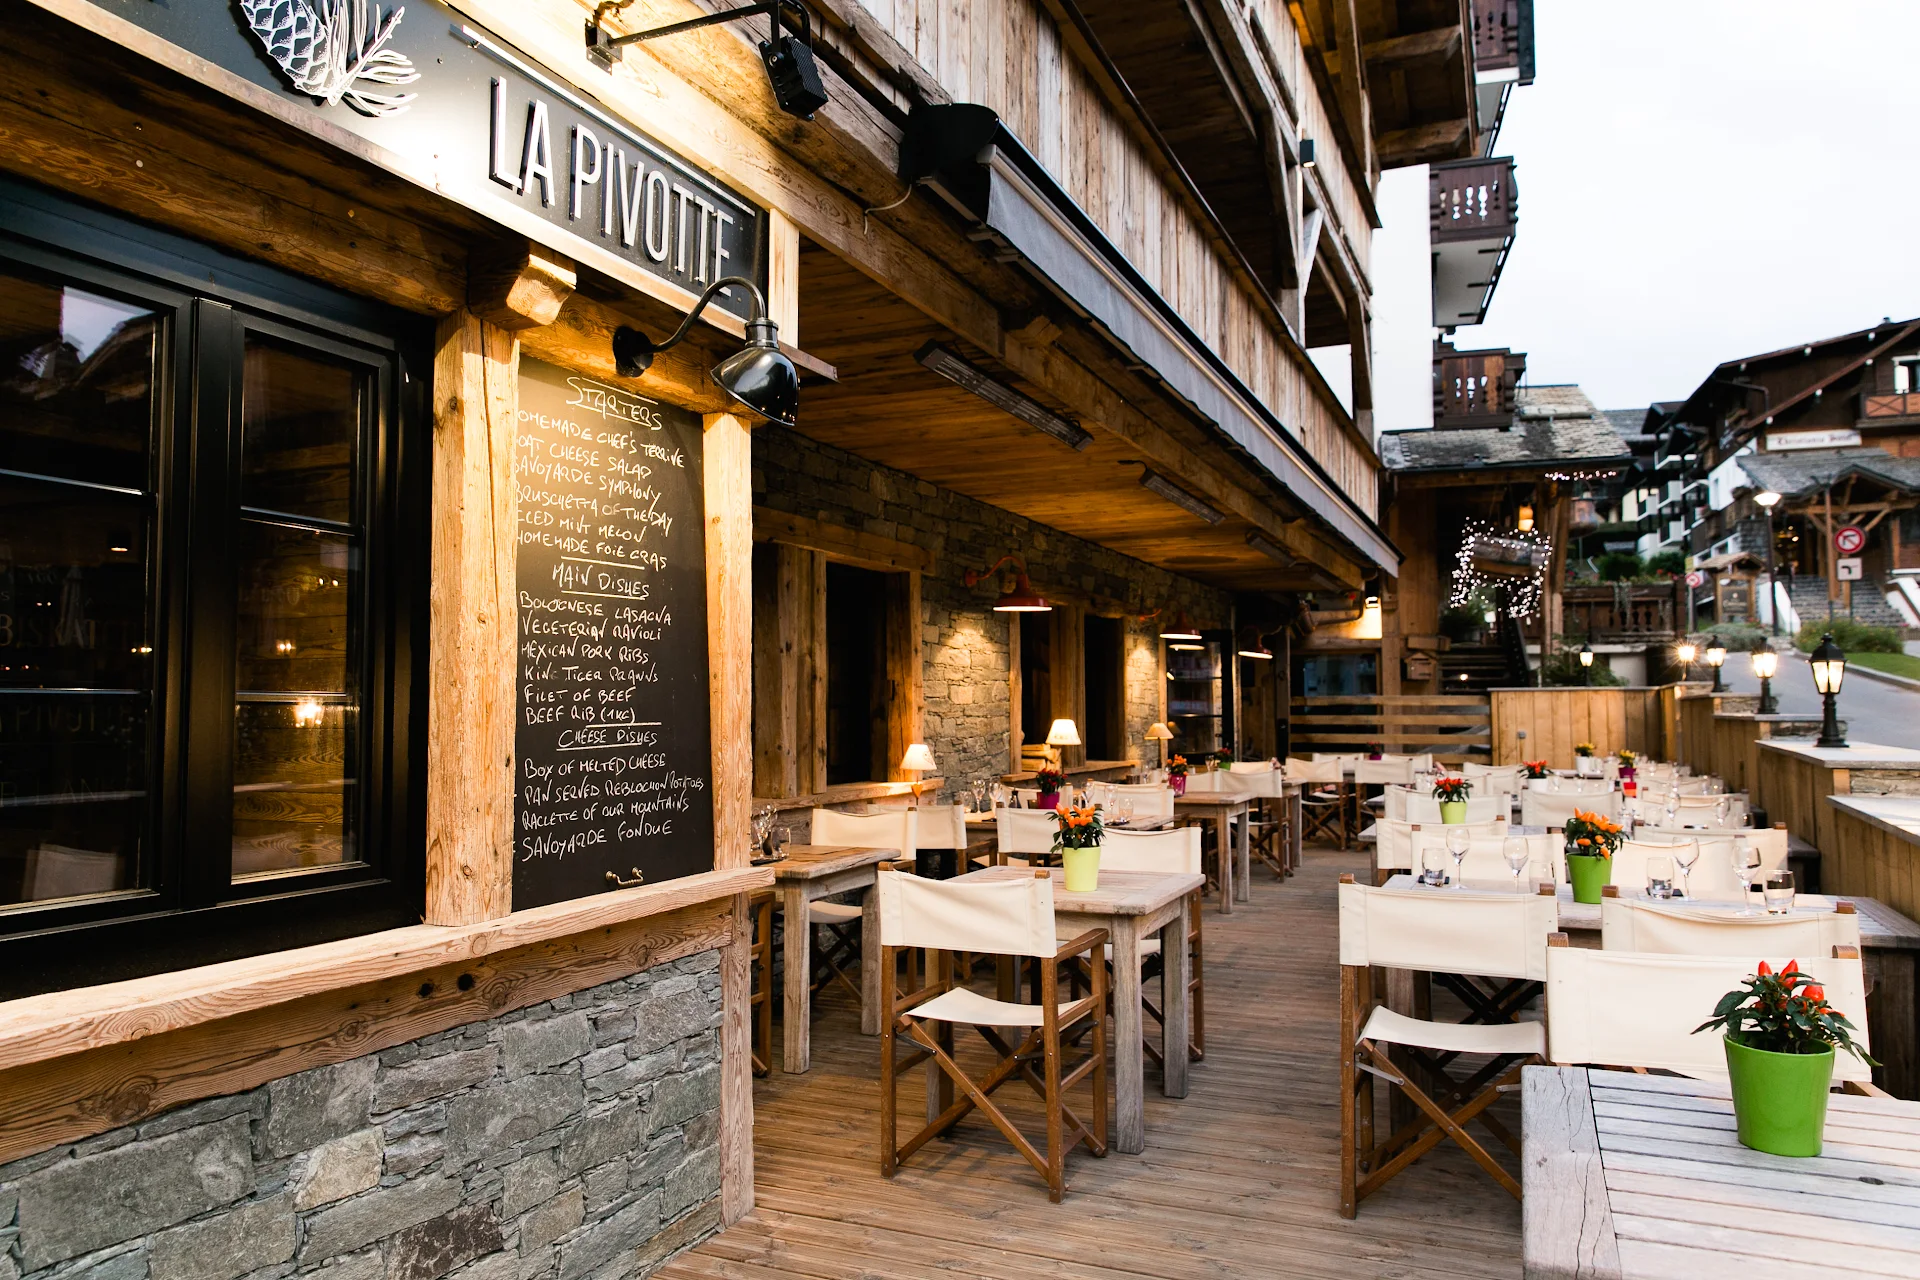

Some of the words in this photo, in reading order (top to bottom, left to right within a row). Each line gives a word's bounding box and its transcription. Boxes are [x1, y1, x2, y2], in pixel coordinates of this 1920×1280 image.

[489, 76, 556, 208] LA
[571, 123, 733, 297] PIVOTTE
[566, 376, 662, 430] STARTERS
[517, 410, 593, 441] OMEMADE
[596, 431, 637, 454] CHEF'S
[516, 434, 545, 458] OAT
[549, 443, 600, 467] CHEESE
[607, 456, 652, 481] SALAD
[599, 475, 662, 519] SYMPHONY
[598, 525, 647, 543] MELON
[602, 503, 620, 516] OF
[620, 507, 648, 522] THE
[651, 511, 673, 537] DAY
[517, 530, 590, 554] HOMEMADE
[630, 550, 667, 572] GRAS
[519, 590, 604, 616] BOLOGNESE
[614, 605, 671, 626] LASAGNA
[581, 644, 612, 660] PORK
[610, 662, 658, 685] PRAWNS
[573, 688, 591, 702] OF
[598, 686, 636, 704] BEEF
[525, 705, 565, 726] BEEF
[558, 729, 607, 748] CHEESE
[524, 758, 554, 781] BOX
[558, 759, 575, 776] OF
[579, 757, 626, 776] MELTED
[629, 753, 666, 770] CHEESE
[524, 779, 553, 806] PAN
[555, 775, 600, 803] SERVED
[604, 772, 668, 797] REBLOCHON
[521, 810, 578, 831] RACLETTE
[583, 802, 599, 821] OF
[601, 803, 625, 817] OUR
[521, 831, 607, 863] SAVOYARDE
[617, 812, 672, 842] FONDUE
